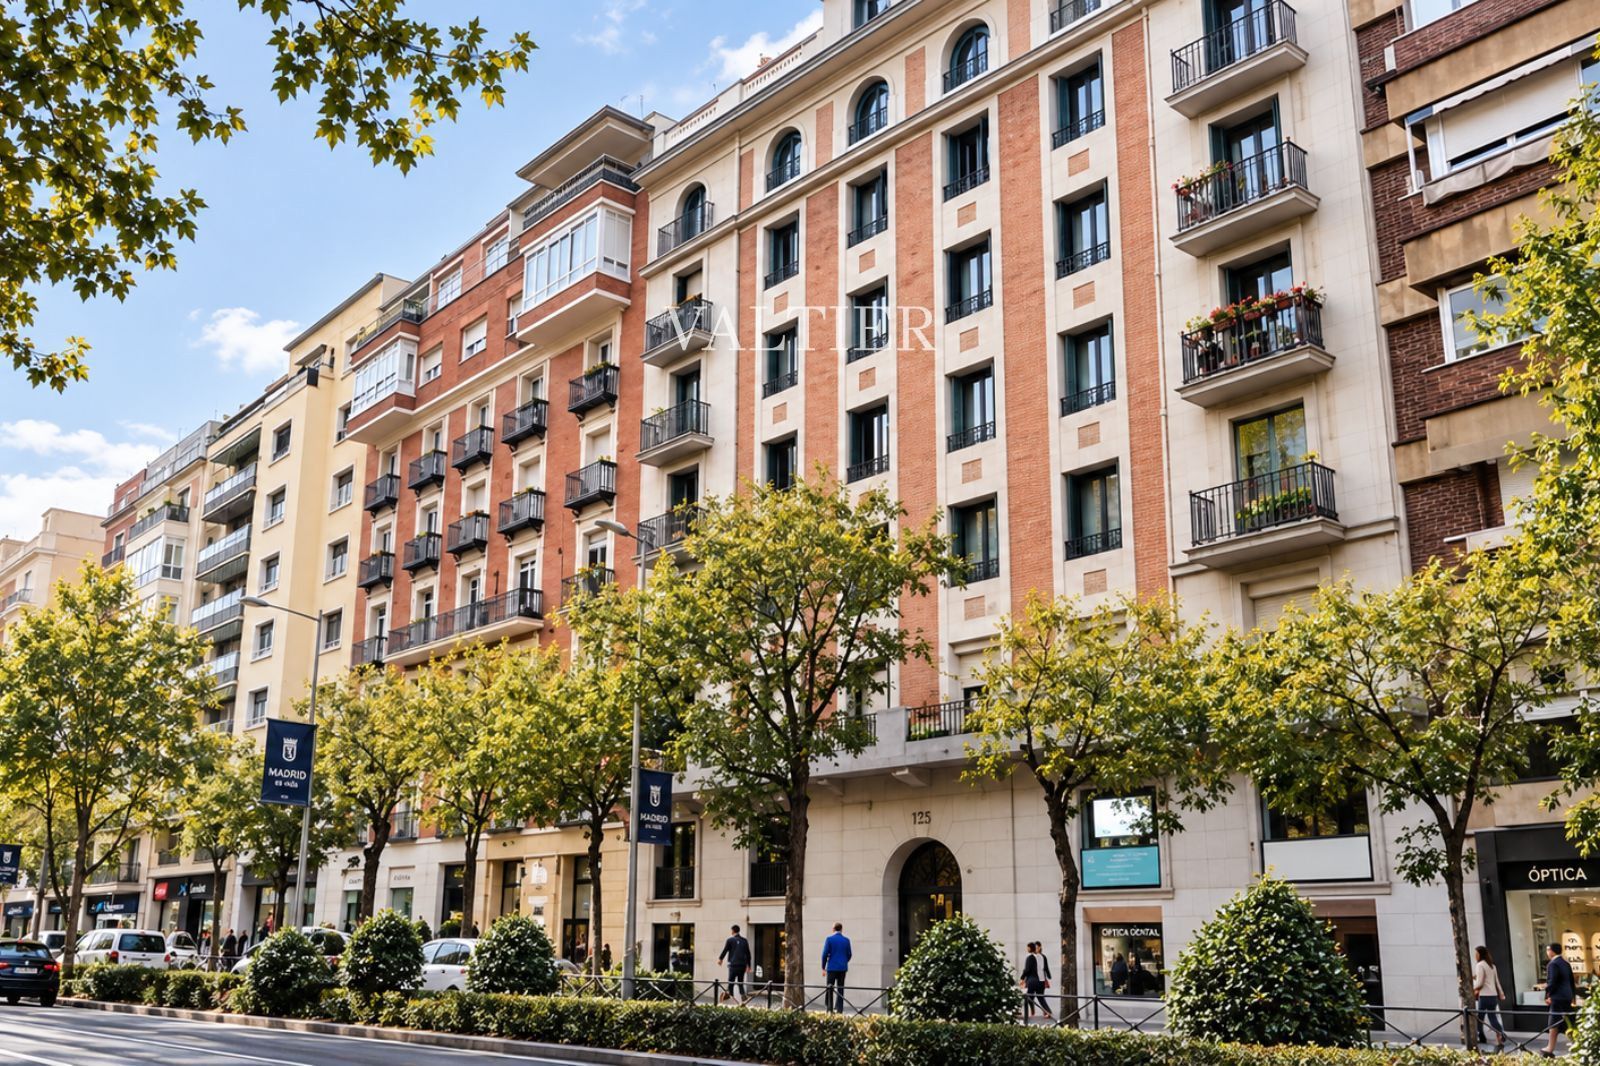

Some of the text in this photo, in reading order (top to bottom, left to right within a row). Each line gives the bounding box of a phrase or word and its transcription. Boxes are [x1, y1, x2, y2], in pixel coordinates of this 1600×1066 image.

[268, 767, 307, 780] MADRID
[911, 810, 932, 825] 125
[1528, 865, 1588, 882] ÓPTICA
